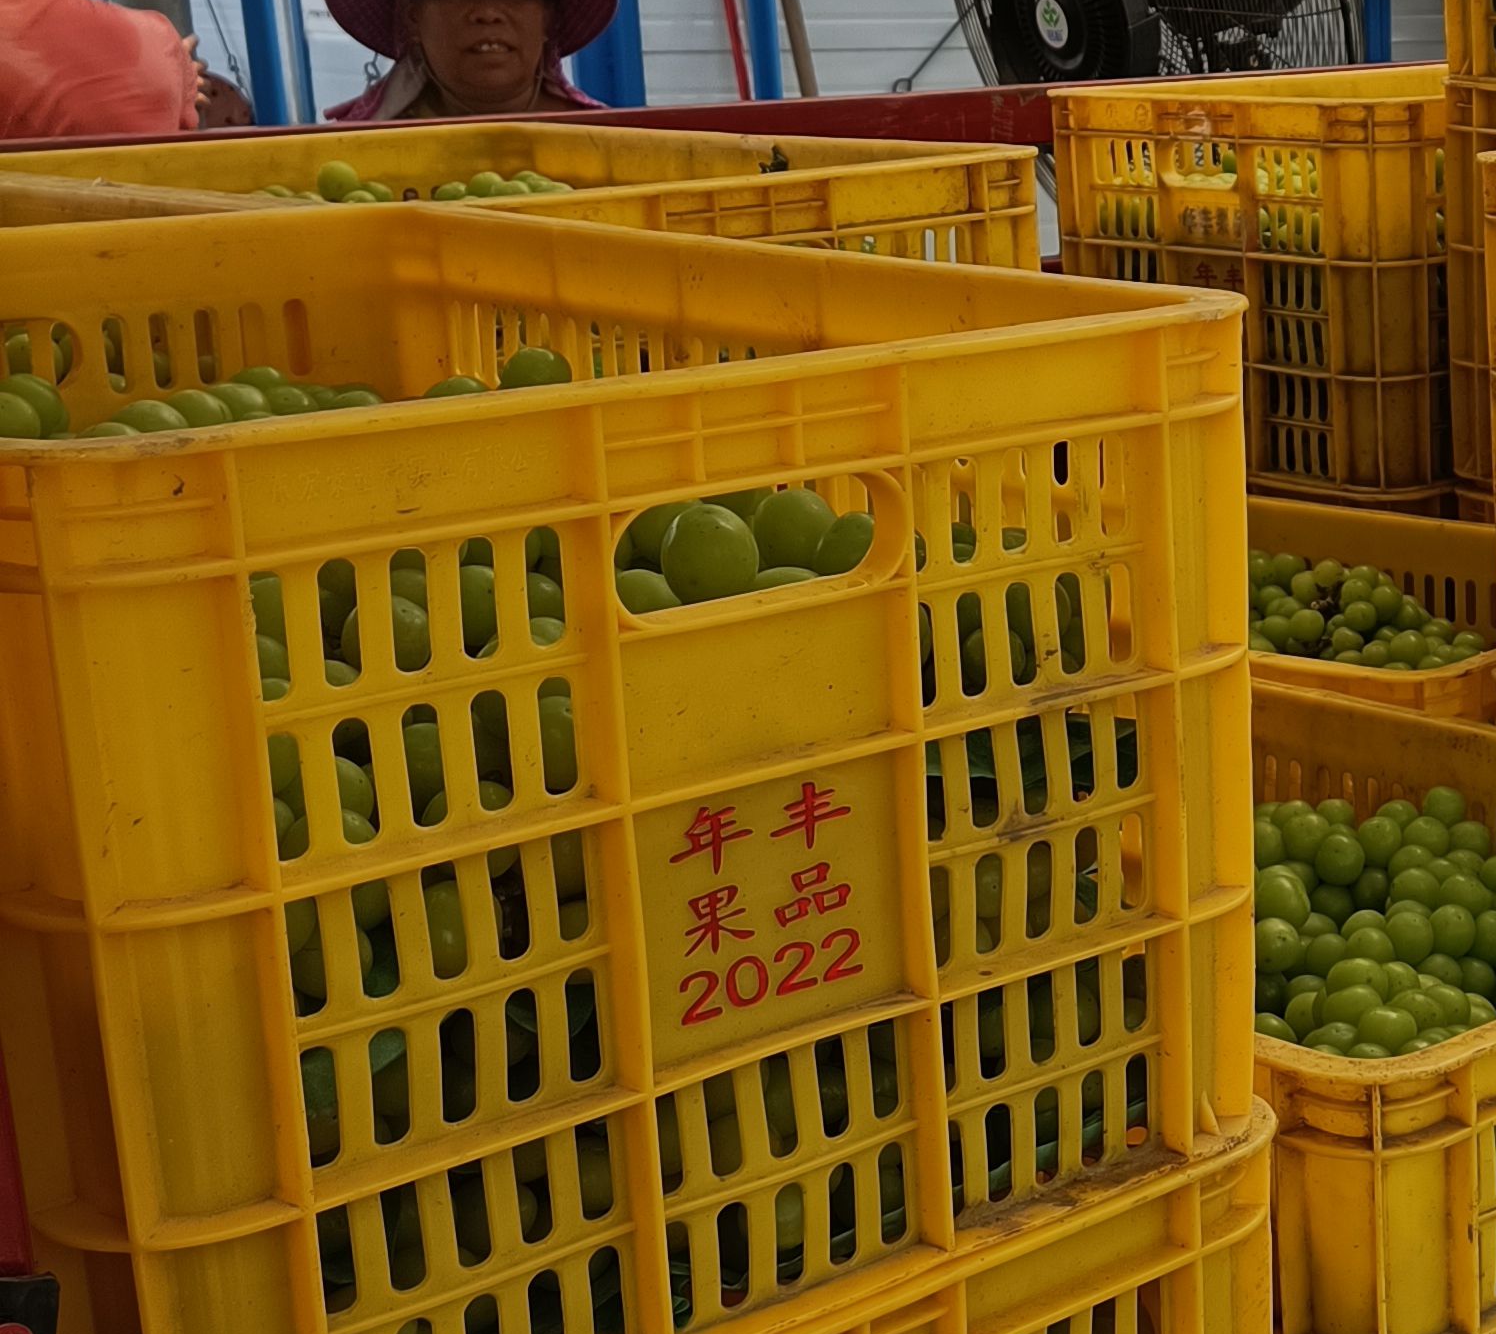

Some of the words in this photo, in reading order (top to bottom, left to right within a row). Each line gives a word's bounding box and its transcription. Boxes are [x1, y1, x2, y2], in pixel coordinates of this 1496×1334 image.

[669, 781, 852, 875] 年丰
[683, 861, 852, 958] 果品
[678, 927, 865, 1027] 2022
